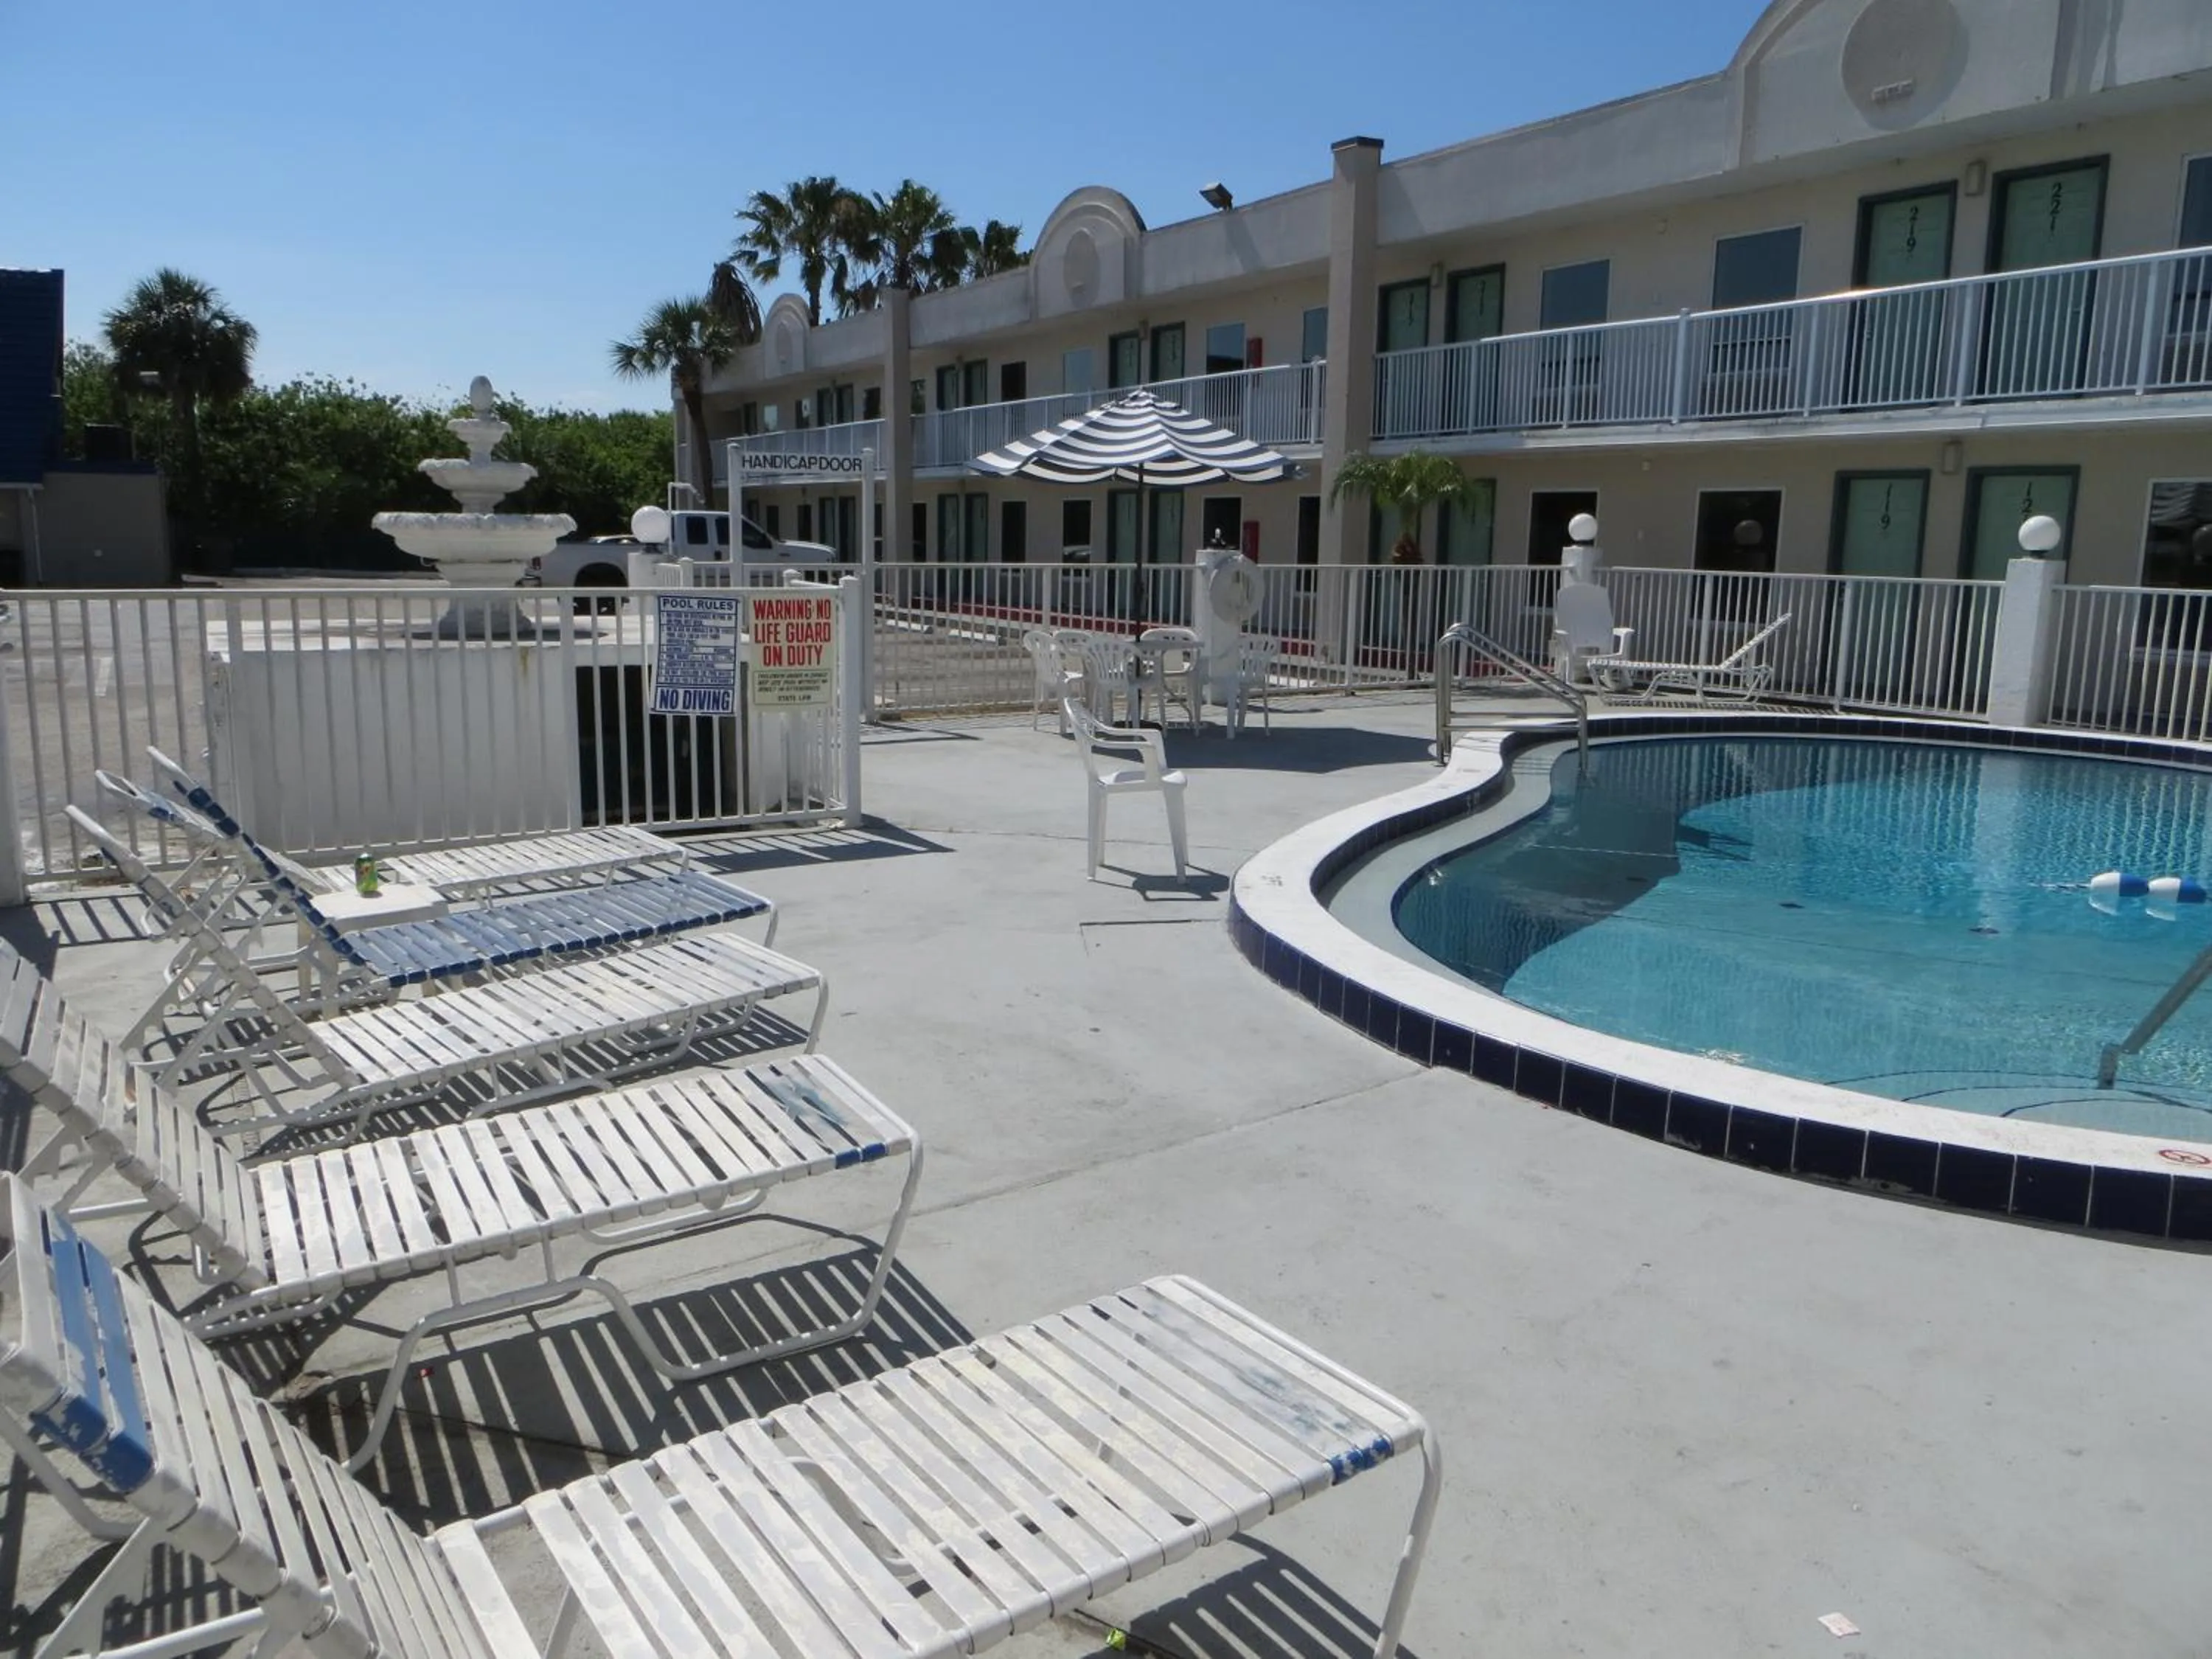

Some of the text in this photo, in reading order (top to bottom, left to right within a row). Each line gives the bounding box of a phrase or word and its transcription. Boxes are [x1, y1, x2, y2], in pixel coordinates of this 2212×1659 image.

[2049, 182, 2062, 232] 221
[1906, 205, 1919, 253] 219
[1881, 481, 1893, 530] 119
[2021, 481, 2034, 521] 12
[662, 599, 734, 611] POOL RULES
[753, 598, 812, 620] WARNING
[816, 598, 832, 620] NO
[754, 623, 781, 644] LIFE
[785, 622, 832, 644] GUARD
[763, 644, 824, 667] ON DUTY
[658, 689, 731, 711] NO DIVING
